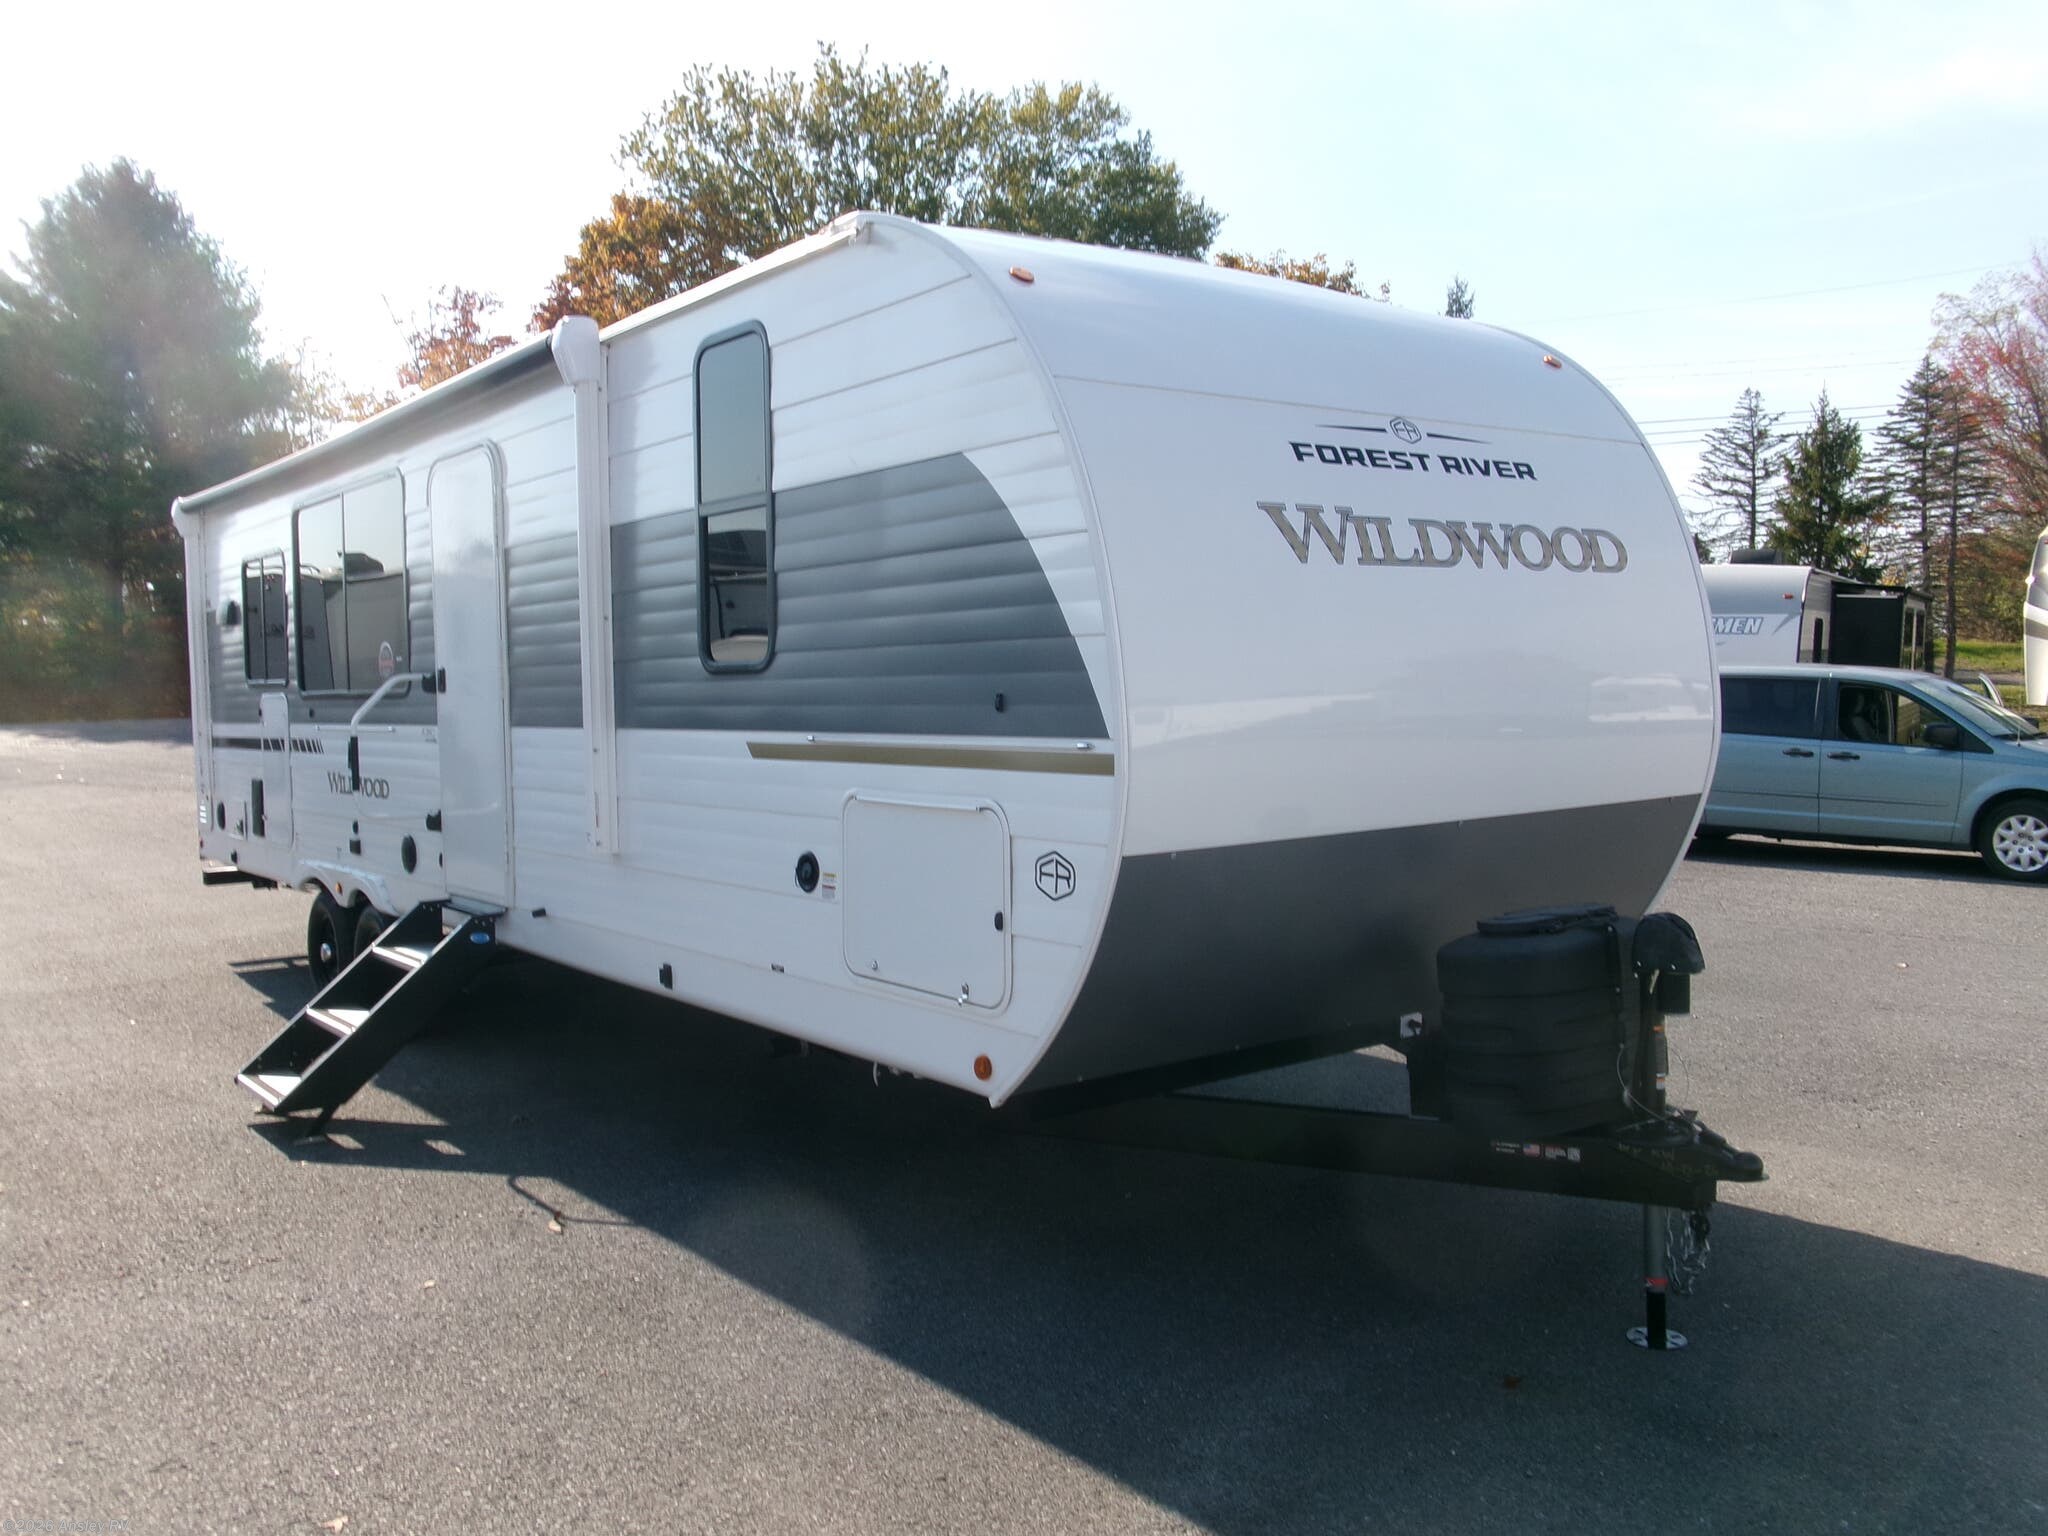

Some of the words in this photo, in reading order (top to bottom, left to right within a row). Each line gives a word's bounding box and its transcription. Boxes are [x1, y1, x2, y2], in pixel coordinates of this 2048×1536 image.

[1289, 440, 1430, 473] FOREST
[1438, 454, 1538, 481] RIVER
[1256, 500, 1629, 574] WILDWOOD
[1712, 616, 1764, 635] MEN
[327, 771, 390, 799] WILWOOD
